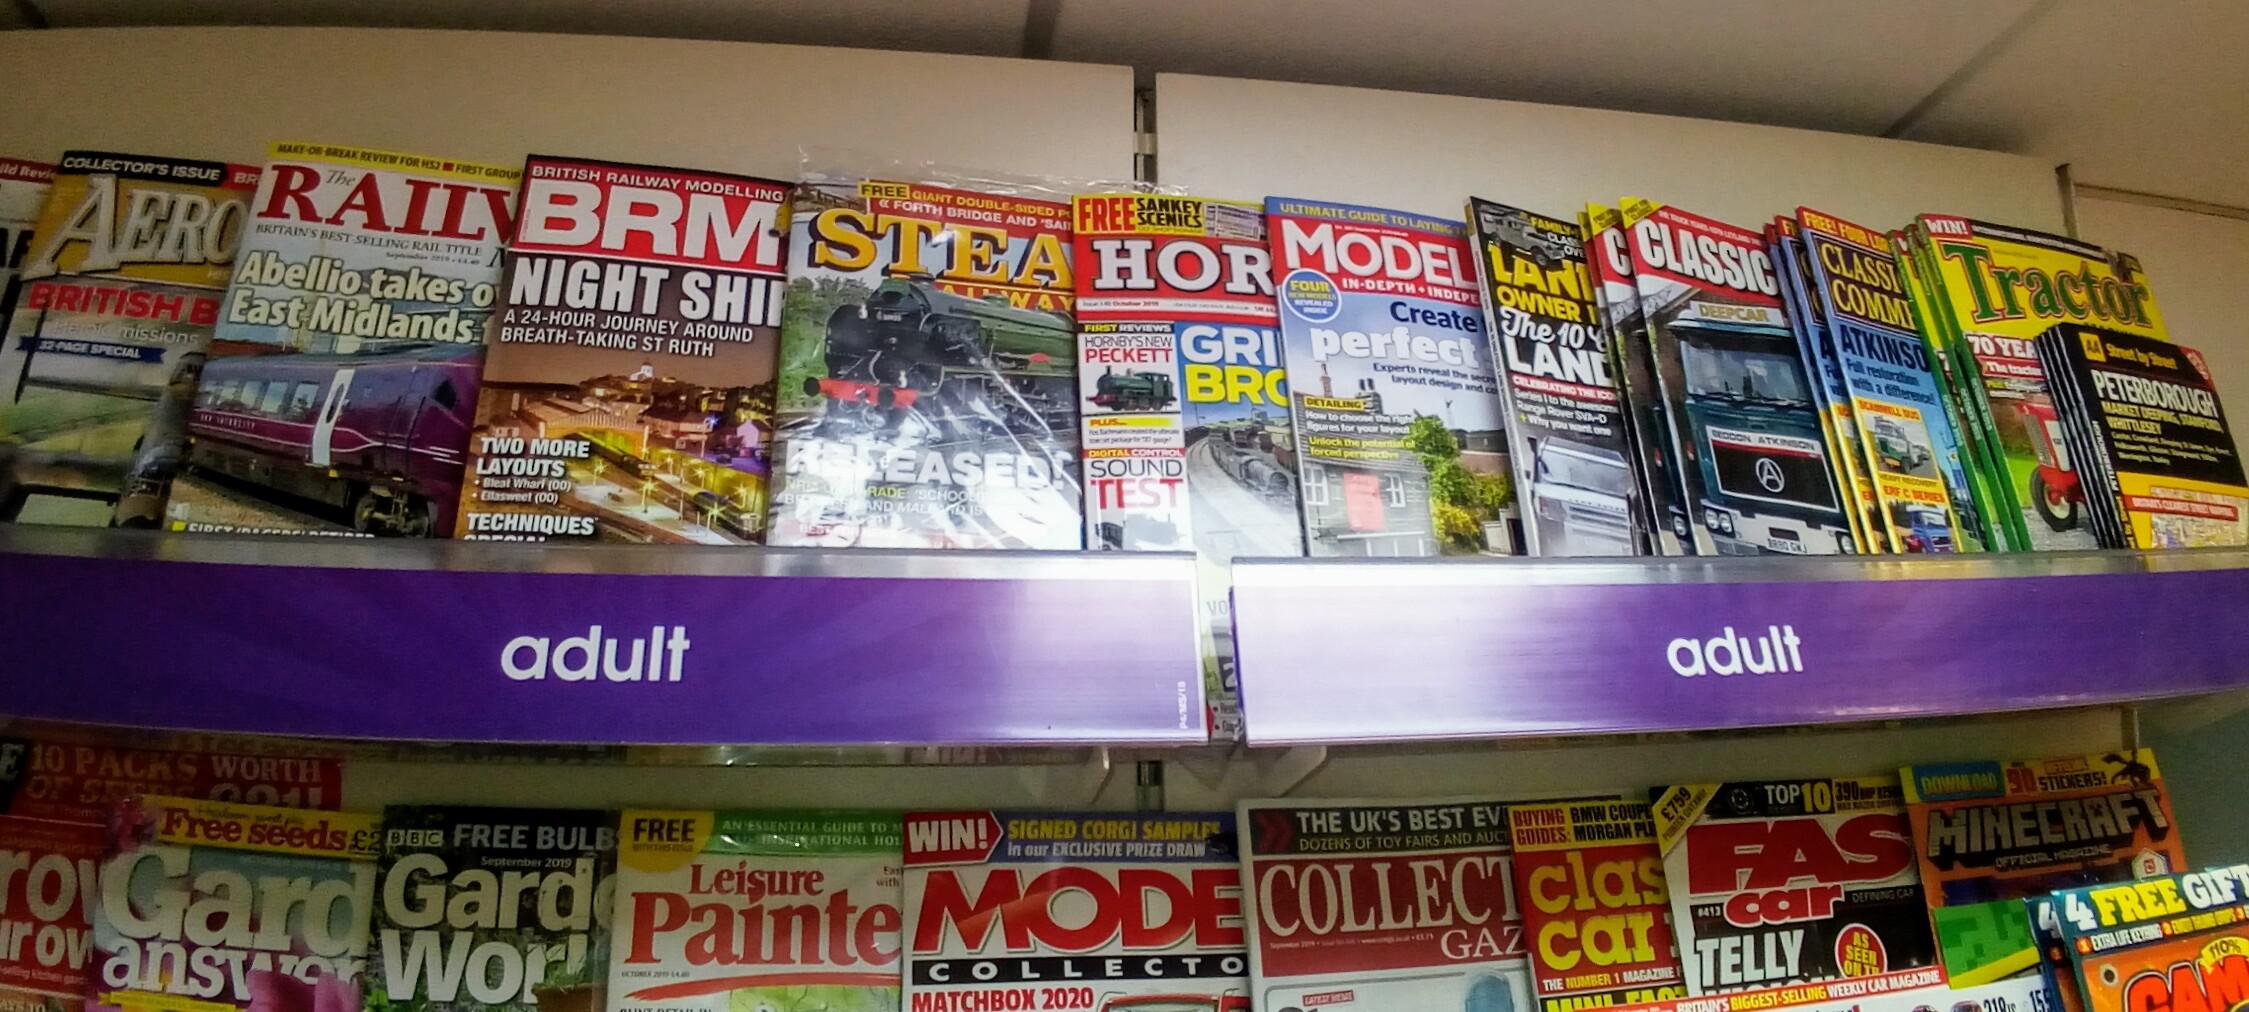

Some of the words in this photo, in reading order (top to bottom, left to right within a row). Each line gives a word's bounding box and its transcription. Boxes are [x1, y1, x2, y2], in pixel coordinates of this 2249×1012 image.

[63, 156, 169, 176] COLLECTOR'S
[171, 165, 222, 182] ISSUE
[360, 151, 398, 165] REVIEW
[400, 155, 420, 168] FOR
[421, 158, 441, 171] HS2
[455, 163, 484, 176] FIRST
[325, 168, 356, 187] The
[532, 165, 601, 182] BRITISH
[606, 172, 681, 190] RAILWAY
[684, 179, 784, 202] MODELLING
[860, 184, 909, 199] FREE
[911, 189, 952, 204] GIANT
[955, 195, 1055, 217] DOUBLE-SIDED
[1136, 198, 1203, 214] SANKEY
[518, 178, 782, 268] BRM
[893, 200, 943, 216] FORTH
[946, 207, 1003, 224] BRIDGE
[1005, 215, 1037, 228] AND
[1078, 197, 1137, 232] FREE
[1136, 212, 1203, 228] SCENICS
[1279, 203, 1346, 219] ULTIMATE
[1349, 209, 1388, 224] GUIDE
[1391, 215, 1408, 227] TO
[1925, 218, 1967, 236] WIN!
[255, 222, 317, 239] BRITAIN'S
[411, 240, 439, 253] RAIL
[445, 243, 482, 257] TITLE
[808, 207, 1074, 290] STEA
[1091, 238, 1276, 296] HOR
[1281, 219, 1479, 290] MODEL
[1634, 217, 1780, 296] CLASSIC
[235, 250, 363, 297] Abellio
[370, 265, 466, 306] takes
[508, 256, 671, 316] NIGHT
[1290, 281, 1329, 293] FOUR
[1341, 277, 1417, 294] IN-DEPTH
[1938, 240, 2153, 329] Tractor
[28, 282, 187, 322] BRITISH
[1496, 285, 1582, 323] OWNER
[1699, 304, 1768, 322] DEEPCAR
[228, 287, 304, 329] East
[308, 297, 475, 344] Midlands
[520, 308, 596, 329] 24-HOUR
[600, 315, 680, 337] JOURNEY
[683, 324, 754, 343] AROUND
[1084, 323, 1118, 333] FIRST
[1118, 324, 1172, 333] REVIEWS
[1389, 301, 1479, 333] Create
[1499, 305, 1556, 343] The
[120, 324, 201, 345] missions
[500, 326, 638, 351] BREATH-TAKING
[641, 336, 666, 352] ST
[668, 339, 715, 358] RUTH
[1084, 335, 1144, 348] HORNBY'S
[1145, 337, 1173, 348] NEW
[1968, 335, 1991, 355] 70
[90, 342, 141, 358] SPECIAL
[1085, 347, 1173, 364] PECKETT
[1310, 326, 1480, 370] perfect
[1373, 362, 1417, 374] Experts
[1418, 367, 1450, 378] reveal
[1391, 375, 1427, 387] layout
[1428, 379, 1463, 392] design
[2090, 369, 2219, 419] PETERBOROUGH
[1306, 397, 1362, 410] DETAILING
[480, 436, 525, 456] TWO
[530, 438, 591, 459] MORE
[1088, 448, 1131, 458] DIGITAL
[1131, 449, 1184, 458] CONTROL
[1308, 436, 1343, 448] Unlock
[1343, 449, 1399, 461] perspective
[1757, 436, 1816, 451] ATKINSON
[475, 456, 567, 478] LAYOUTS
[1090, 458, 1183, 478] SOUND
[1090, 478, 1184, 510] TEST
[466, 512, 597, 537] TECHNIQUES
[501, 624, 691, 682] adult
[1666, 624, 1804, 678] adult
[75, 746, 198, 780] PACKS
[210, 754, 322, 784] WORTH
[1921, 772, 1998, 794] DOWNLOAD
[2037, 770, 2109, 792] STICKERS!
[1764, 784, 1799, 805] TOP
[1801, 782, 1832, 814] 10
[161, 807, 243, 843] Free
[248, 819, 349, 851] seeds
[747, 820, 816, 834] ESSENTIAL
[822, 822, 864, 834] GUIDE
[1296, 810, 1343, 834] THE
[1350, 810, 1402, 833] UK'S
[1407, 806, 1465, 831] BEST
[1512, 808, 1566, 828] BUYING
[1569, 805, 1607, 824] BMW
[1928, 788, 2169, 863] MINECRAFT
[386, 829, 444, 848] BBC
[453, 823, 530, 849] FREE
[633, 817, 696, 843] FREE
[907, 818, 988, 853] WIN!
[1007, 819, 1078, 841] SIGNED
[1082, 819, 1138, 840] CORGI
[1299, 836, 1351, 852] DOZENS
[1376, 836, 1401, 850] TOY
[1405, 833, 1440, 848] FAIRS
[1442, 831, 1473, 847] AND
[1573, 823, 1633, 842] MORGAN
[480, 855, 543, 868] September
[544, 857, 573, 868] 2019
[1025, 844, 1049, 857] our
[1052, 842, 1124, 858] EXCLUSIVE
[1126, 842, 1164, 857] PRIZE
[1166, 842, 1206, 857] DRAW
[1994, 852, 2052, 868] OFFICIAL
[688, 858, 825, 905] Leisure
[1259, 856, 1524, 937] COLLECT
[1723, 883, 1845, 928] car
[1851, 889, 1895, 904] DEFINING
[2089, 878, 2187, 927] FREE
[912, 866, 1246, 954] MODE
[623, 888, 902, 967] Painte
[1538, 911, 1656, 971] car
[1696, 929, 1804, 988] TELLY
[1845, 946, 1878, 964] SEEN
[928, 955, 1245, 982] COLLECTO
[1542, 977, 1564, 992] THE
[1565, 973, 1612, 990] NUMBER
[1622, 966, 1675, 984] MAGAZINE
[911, 987, 1036, 1012] MATCHBOX
[1040, 986, 1094, 1011] 2020
[1730, 984, 1827, 1010] BIGGEST-SELLING
[1828, 979, 1867, 998] WEEKLY
[1889, 969, 1941, 987] MAGAZINE
